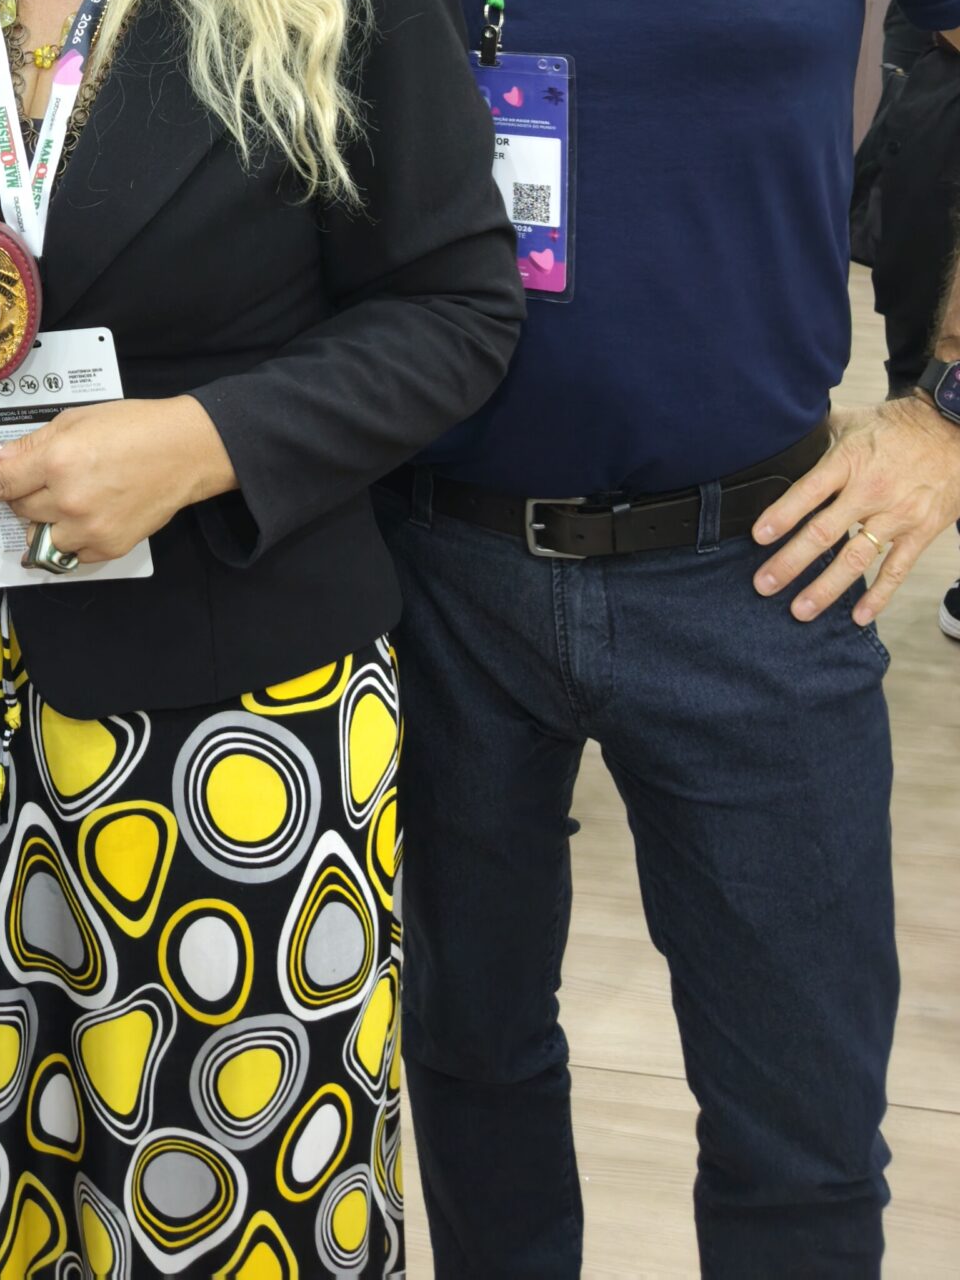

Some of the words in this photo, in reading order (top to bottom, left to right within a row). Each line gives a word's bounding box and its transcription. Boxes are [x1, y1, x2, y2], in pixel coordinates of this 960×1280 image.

[72, 13, 92, 45] 2026
[496, 137, 510, 146] OR
[493, 152, 505, 160] ER
